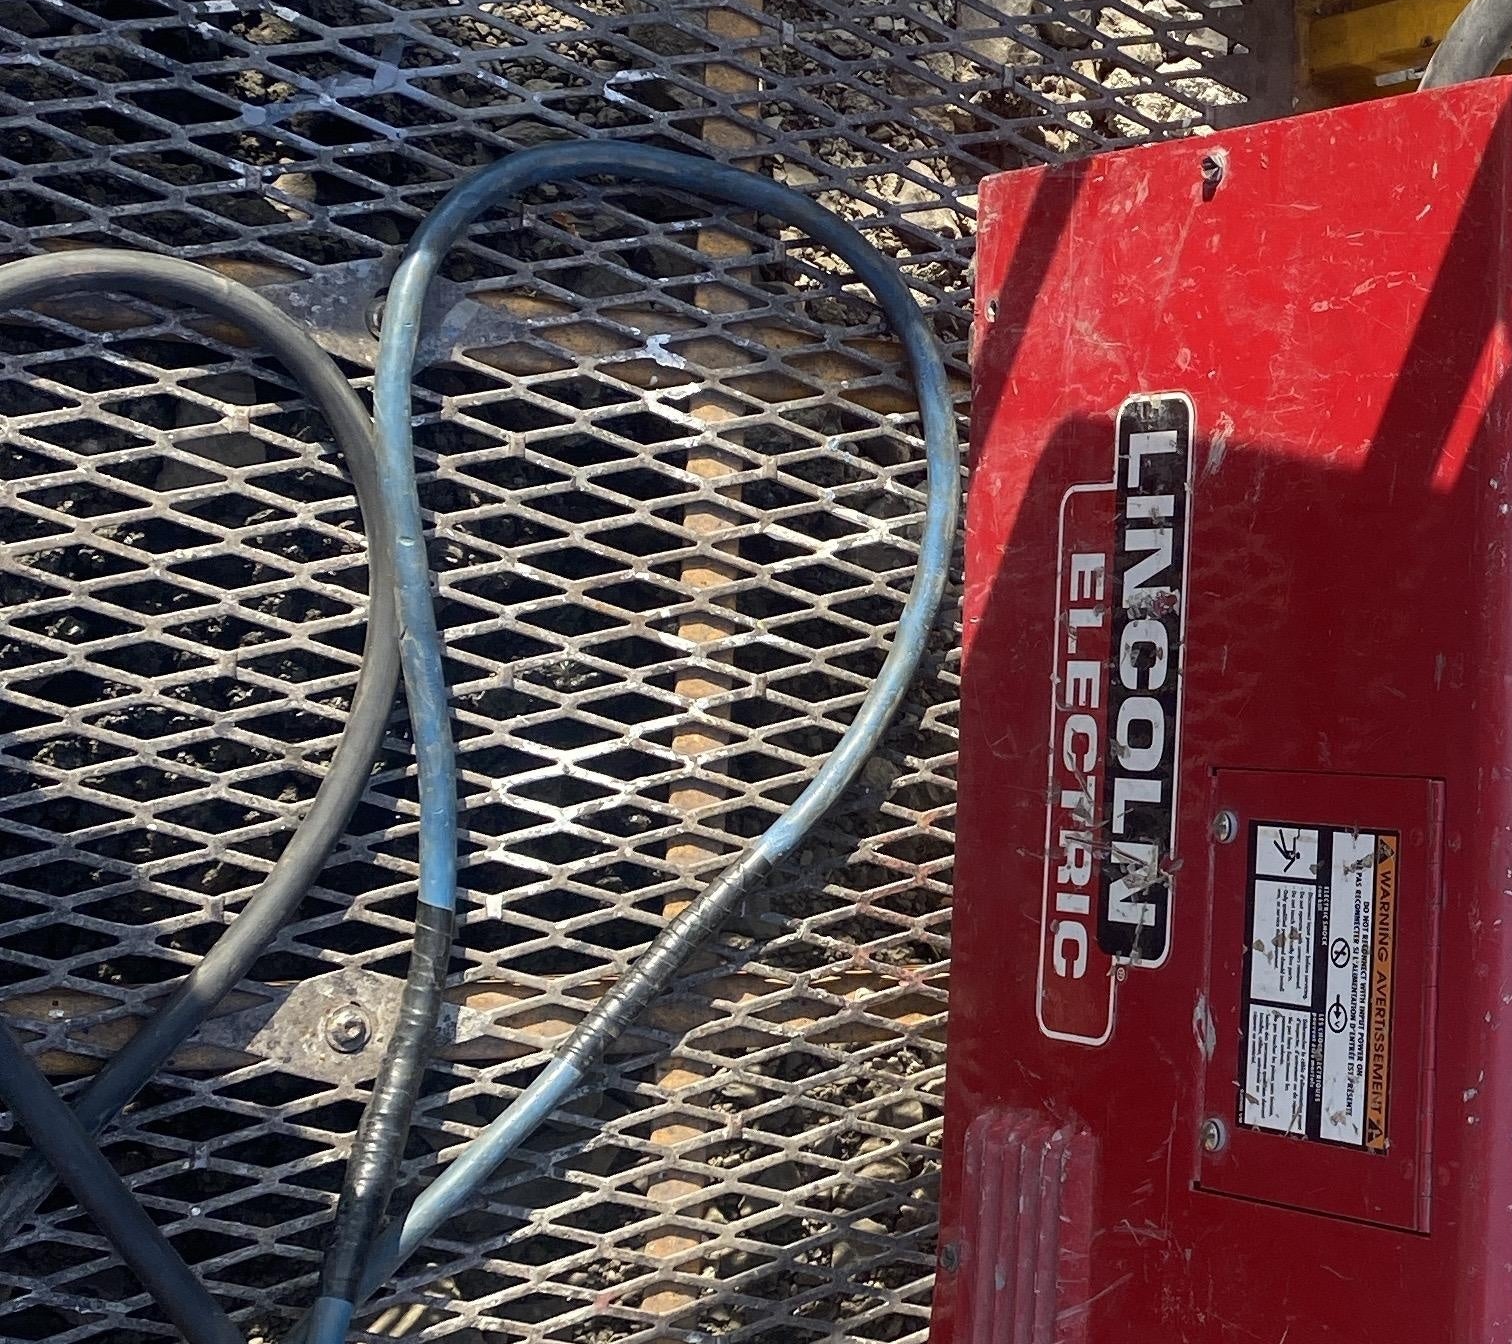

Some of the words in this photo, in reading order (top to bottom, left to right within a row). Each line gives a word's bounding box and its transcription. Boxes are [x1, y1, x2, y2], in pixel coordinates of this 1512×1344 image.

[1108, 430, 1179, 927] LINCOLN
[1053, 552, 1105, 980] ELECTRIC
[1353, 890, 1361, 943] RECONNECTER
[1363, 902, 1369, 913] DO
[1378, 871, 1391, 962] WARNING
[1357, 1060, 1363, 1076] ON
[1371, 971, 1387, 1114] AVERTISSEMENT
